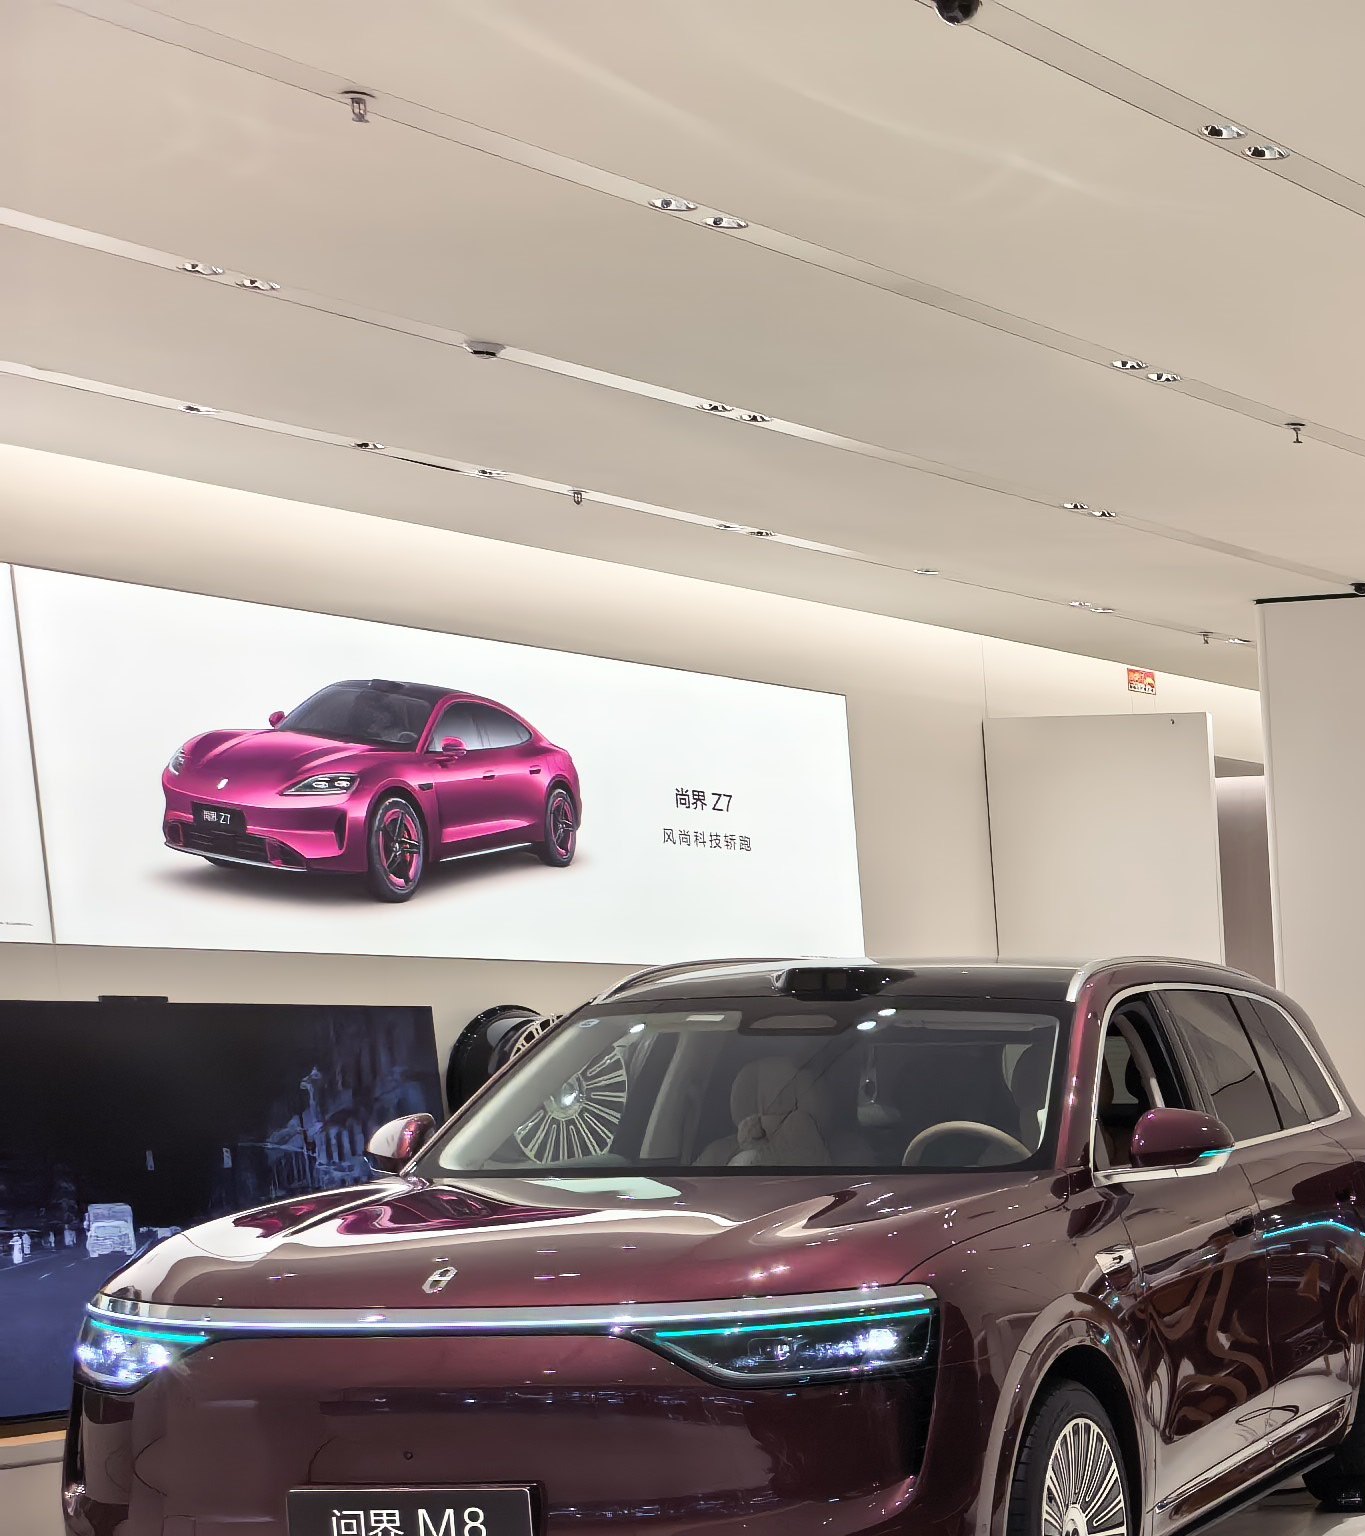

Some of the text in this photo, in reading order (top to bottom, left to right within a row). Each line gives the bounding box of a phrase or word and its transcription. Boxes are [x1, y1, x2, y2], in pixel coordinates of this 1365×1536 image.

[675, 787, 733, 812] 尚界 Z7
[663, 828, 752, 852] 风尚科技轿跑
